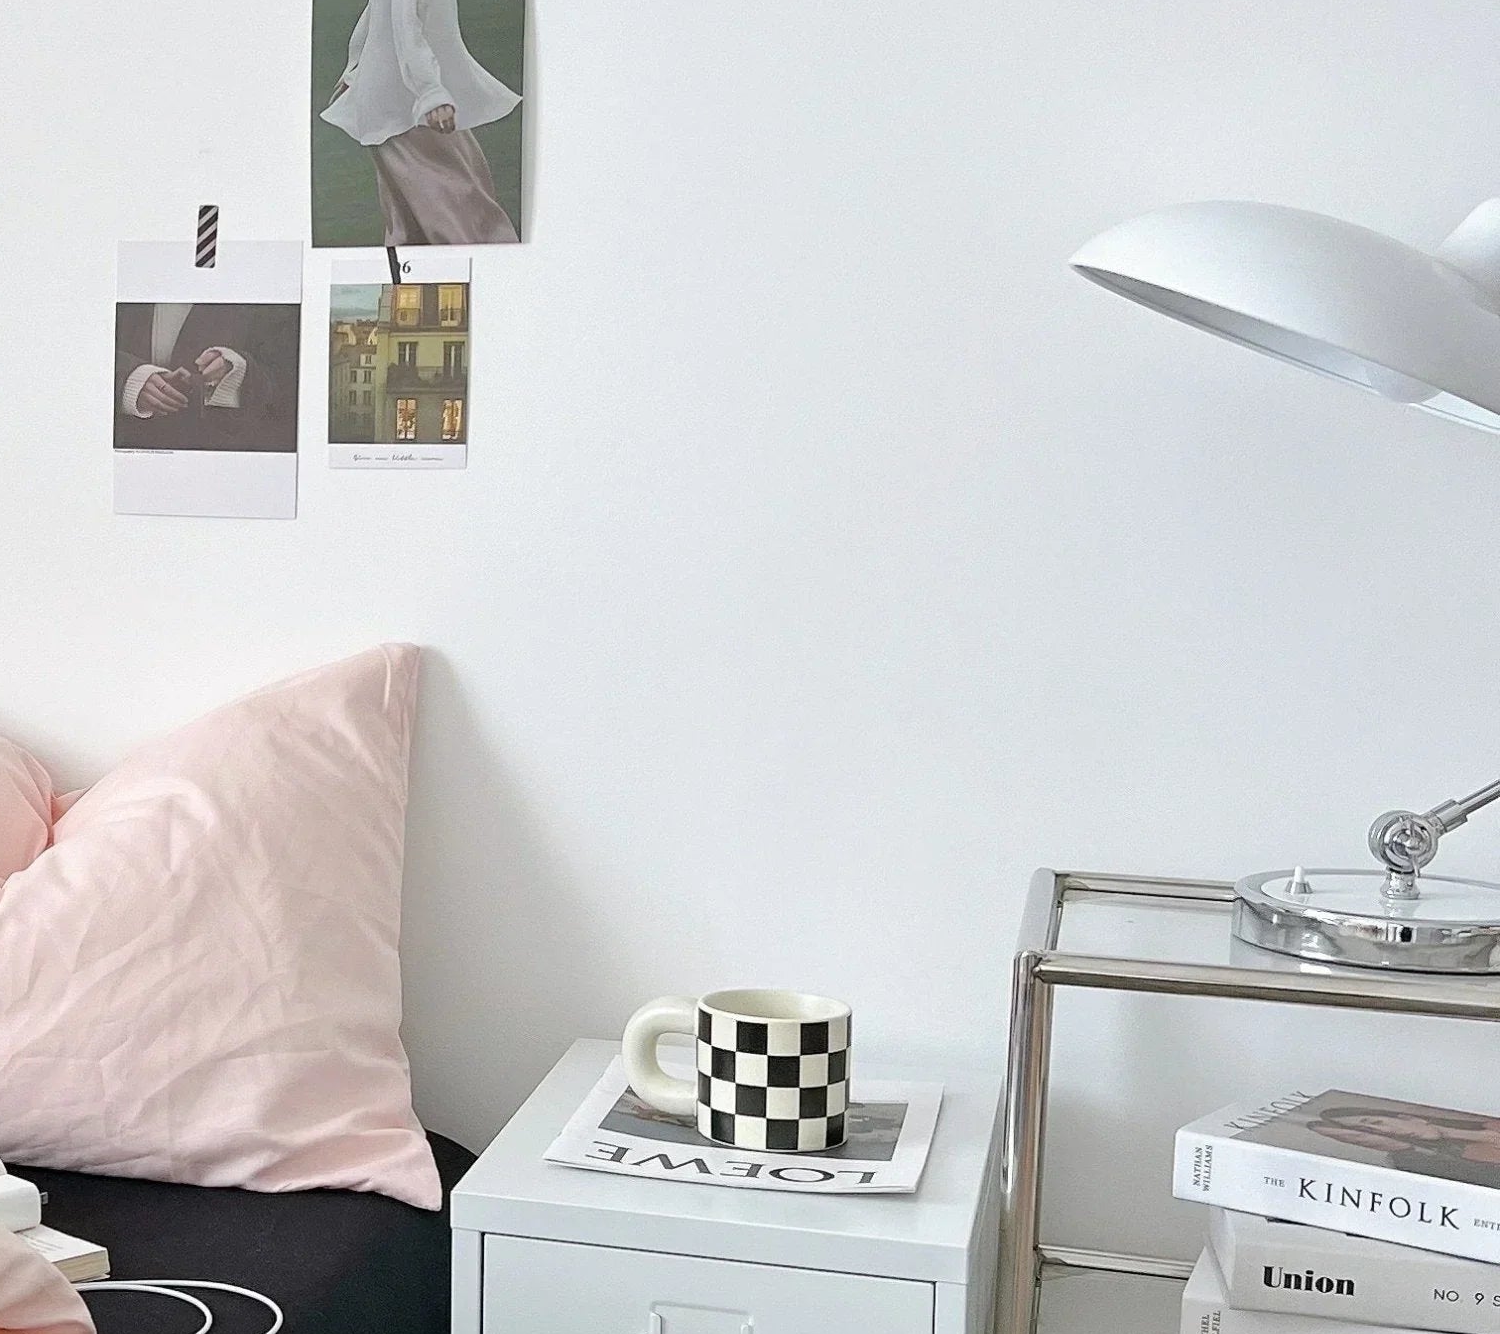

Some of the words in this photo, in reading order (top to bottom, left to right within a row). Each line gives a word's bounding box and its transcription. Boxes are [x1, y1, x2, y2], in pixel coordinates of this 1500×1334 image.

[1223, 1090, 1315, 1131] KINFOLK
[585, 1140, 877, 1185] LOEWE
[1192, 1146, 1203, 1187] NATHAN
[1202, 1144, 1213, 1192] WILLIAMS
[1263, 1176, 1286, 1188] THE
[1298, 1177, 1460, 1230] KINFOLK
[1263, 1265, 1355, 1297] Union
[1475, 1292, 1485, 1306] 9
